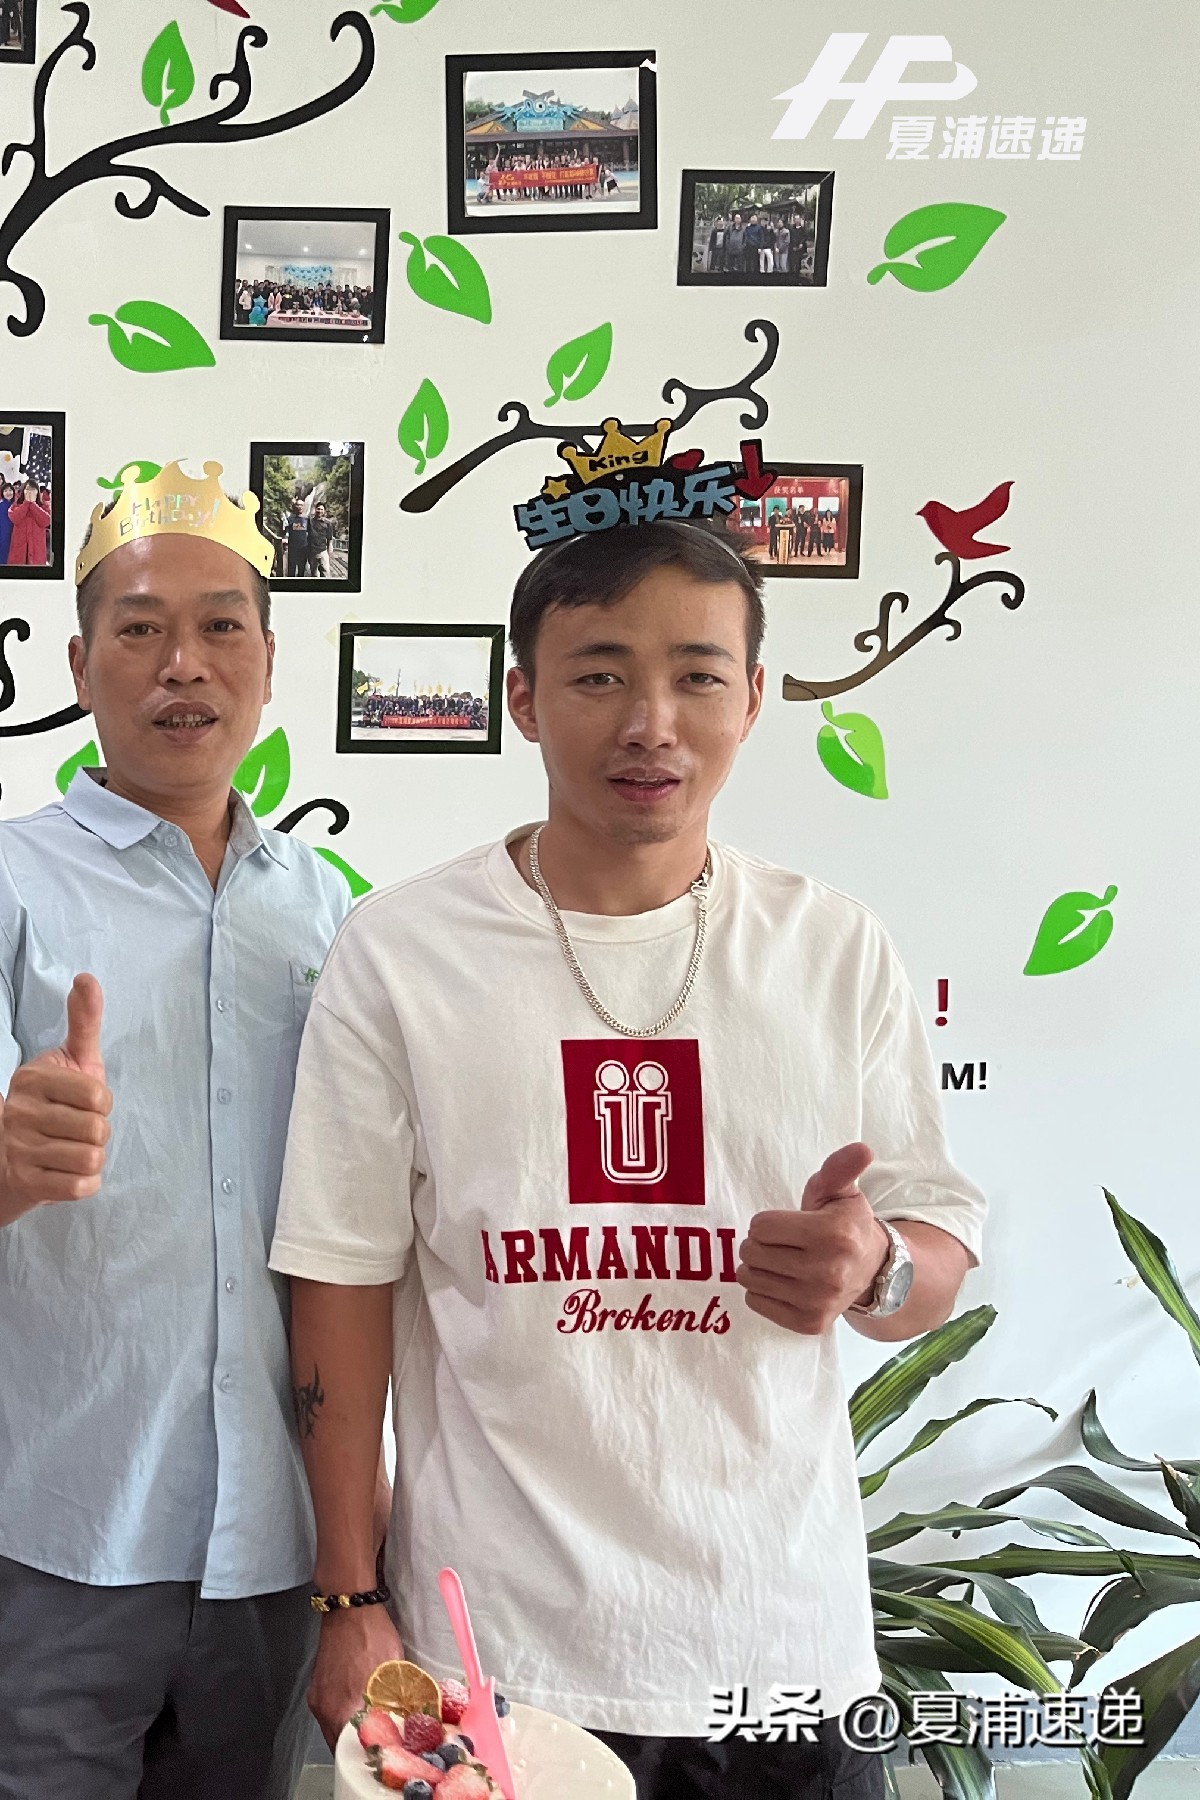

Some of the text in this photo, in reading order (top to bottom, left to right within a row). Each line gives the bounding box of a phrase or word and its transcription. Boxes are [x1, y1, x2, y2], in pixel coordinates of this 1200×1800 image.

[588, 450, 649, 472] King
[517, 465, 737, 548] 生日快乐
[556, 1288, 731, 1334] Brokents
